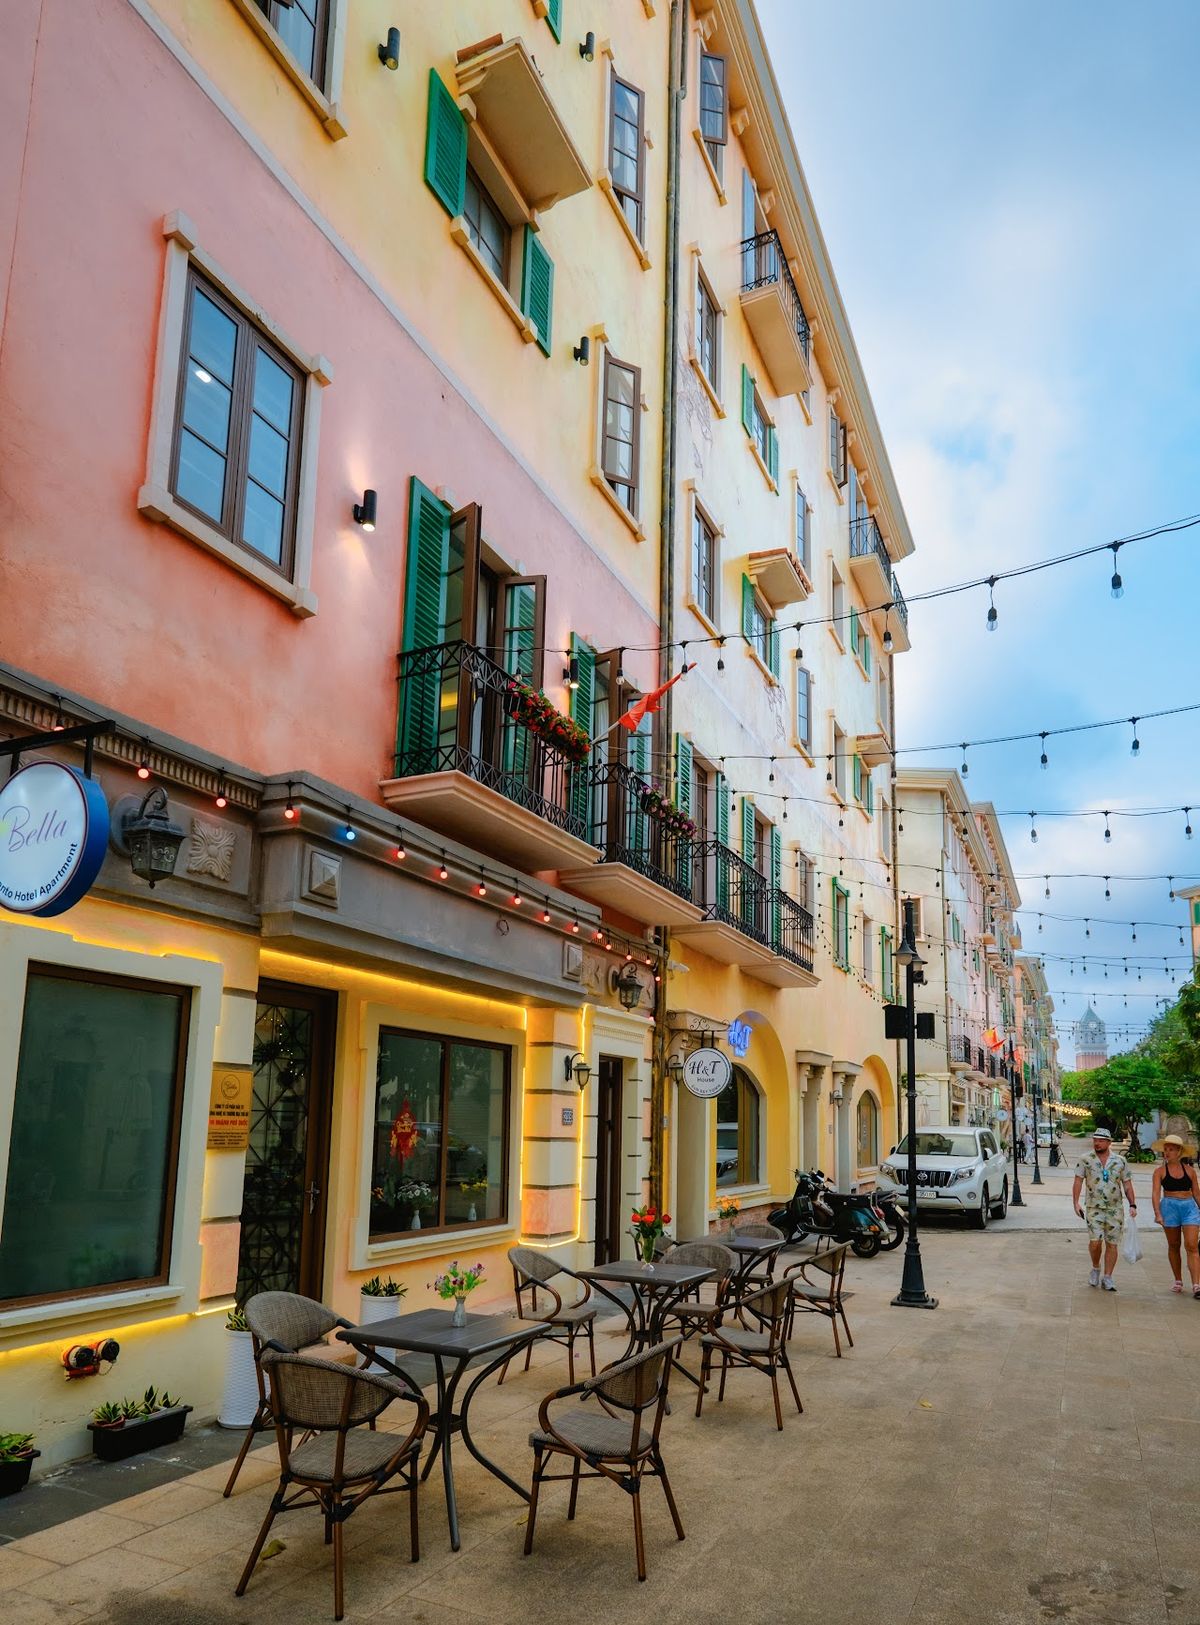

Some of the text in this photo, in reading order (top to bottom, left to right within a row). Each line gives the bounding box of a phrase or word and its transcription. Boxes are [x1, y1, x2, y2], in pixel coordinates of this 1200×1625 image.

[3, 806, 67, 852] Bella
[14, 889, 38, 902] Hotel
[40, 843, 78, 896] Apartment
[689, 1060, 721, 1077] H&T
